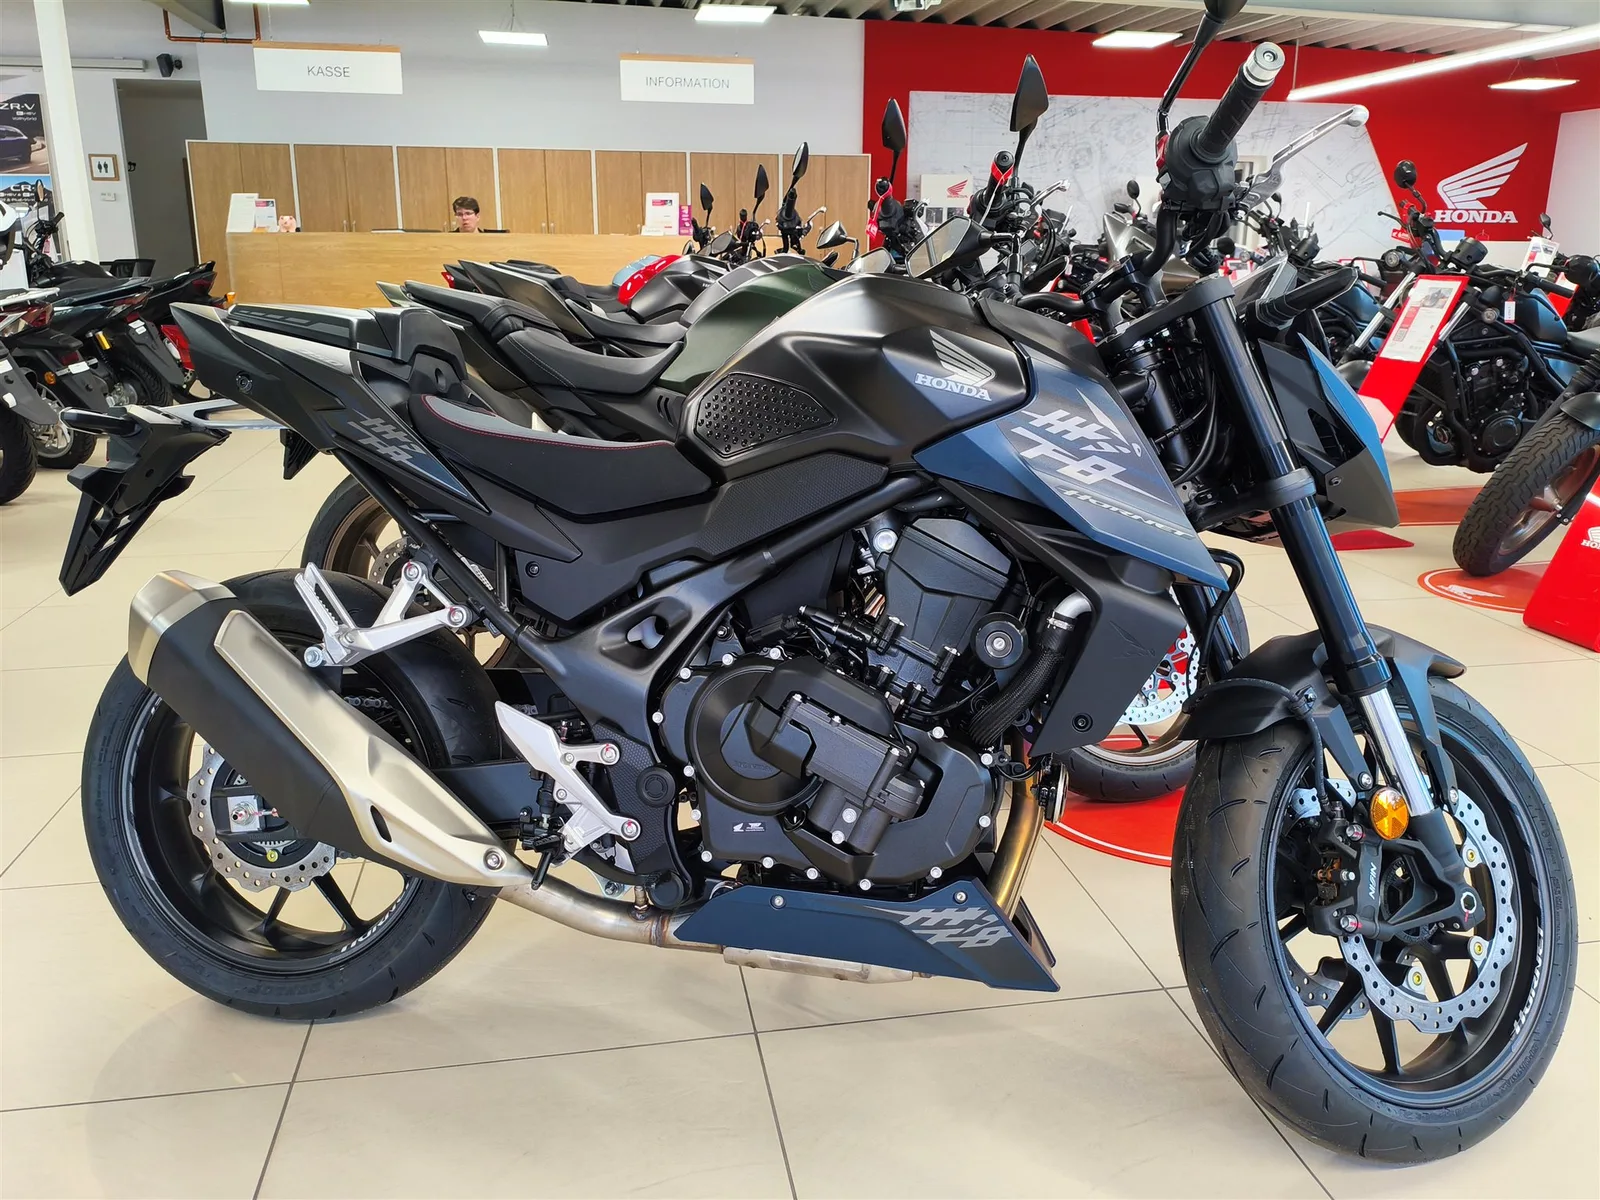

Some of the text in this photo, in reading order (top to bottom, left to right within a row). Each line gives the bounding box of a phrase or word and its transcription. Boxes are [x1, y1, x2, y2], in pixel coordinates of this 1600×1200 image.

[307, 65, 351, 78] KASSE
[645, 76, 730, 89] INFORMATION
[1433, 209, 1519, 224] HONDA
[914, 372, 993, 402] HONDA
